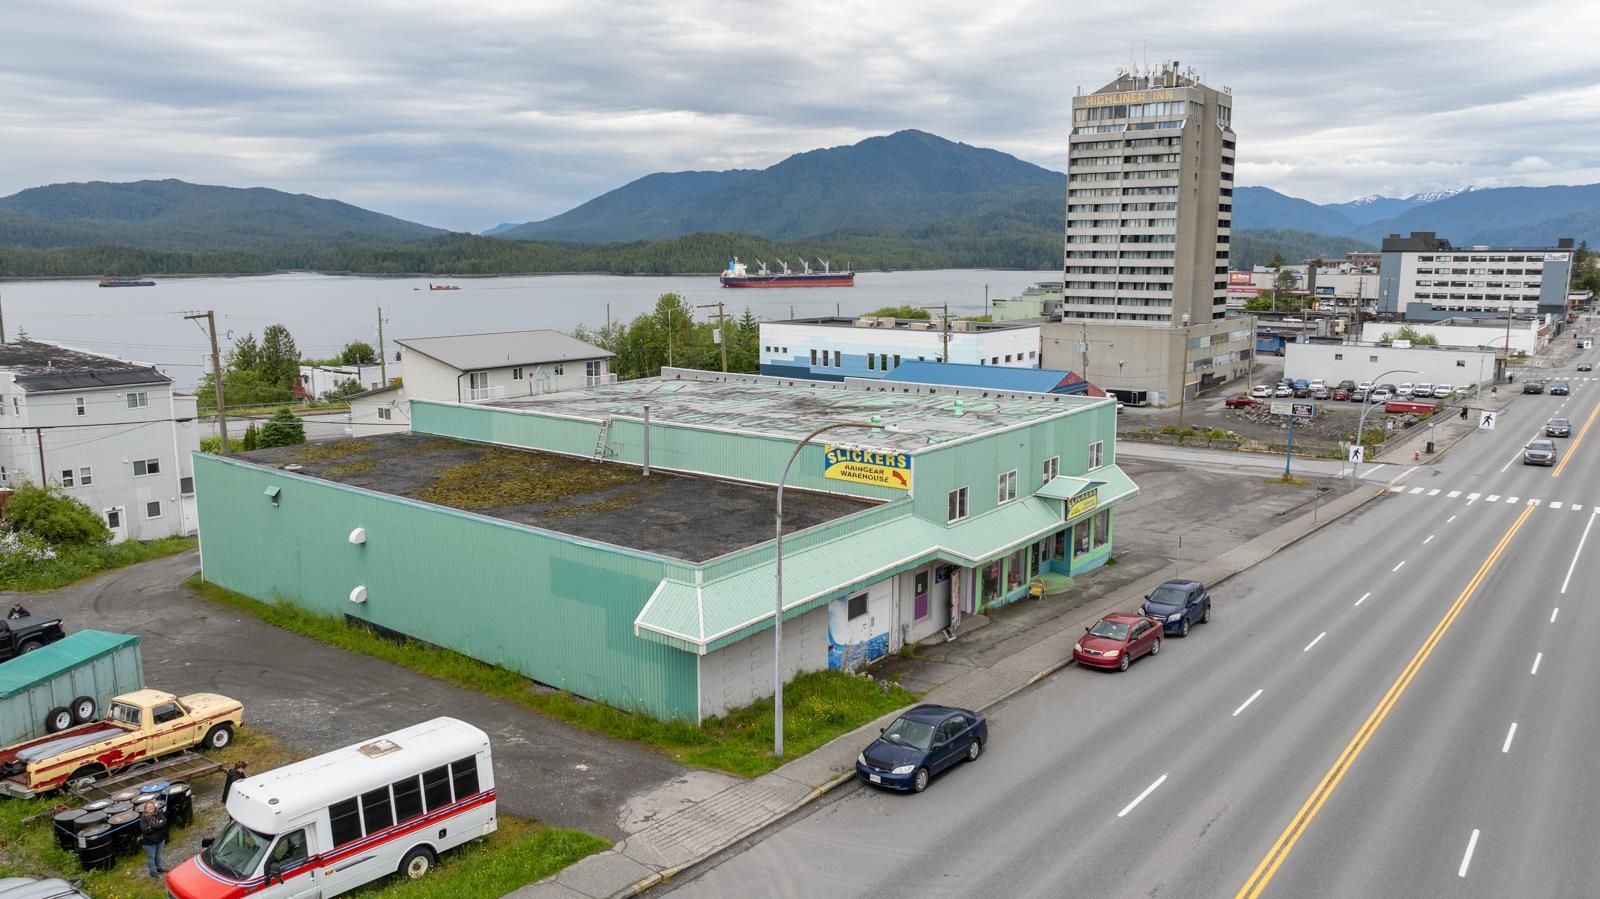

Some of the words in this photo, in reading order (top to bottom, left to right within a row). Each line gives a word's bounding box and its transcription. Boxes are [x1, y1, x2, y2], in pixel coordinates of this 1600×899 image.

[1085, 92, 1146, 106] HIGHLINER
[1152, 90, 1173, 100] INN
[827, 449, 907, 468] SLICKERS
[840, 470, 889, 483] WAREHOUSE
[845, 464, 885, 475] RAINGEAR
